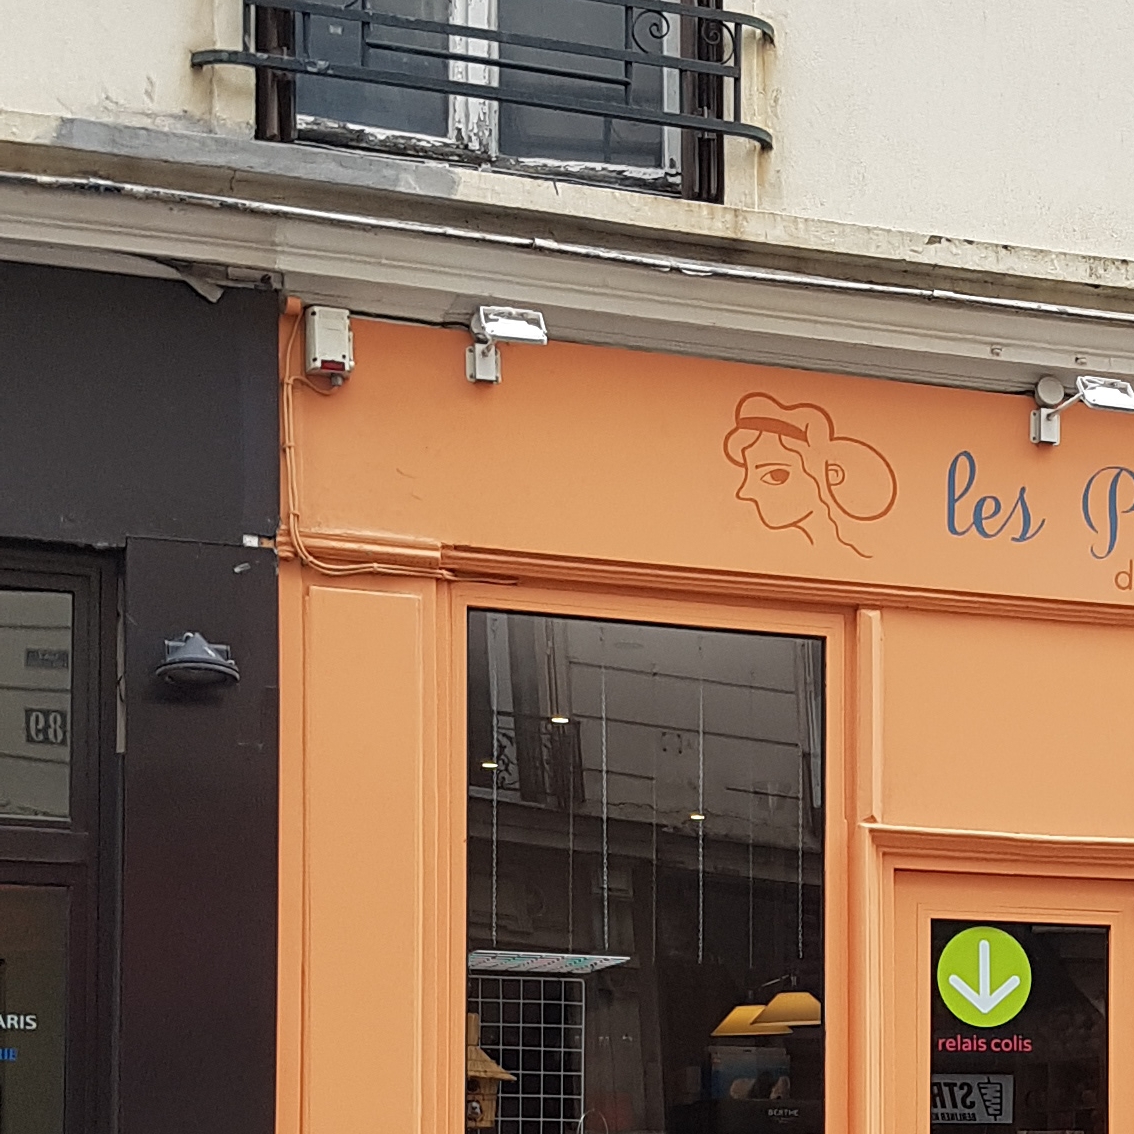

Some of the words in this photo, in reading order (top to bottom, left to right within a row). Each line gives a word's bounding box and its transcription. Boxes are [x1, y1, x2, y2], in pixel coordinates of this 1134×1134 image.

[946, 450, 1046, 543] les
[937, 1034, 987, 1051] relais
[990, 1034, 1033, 1052] colis
